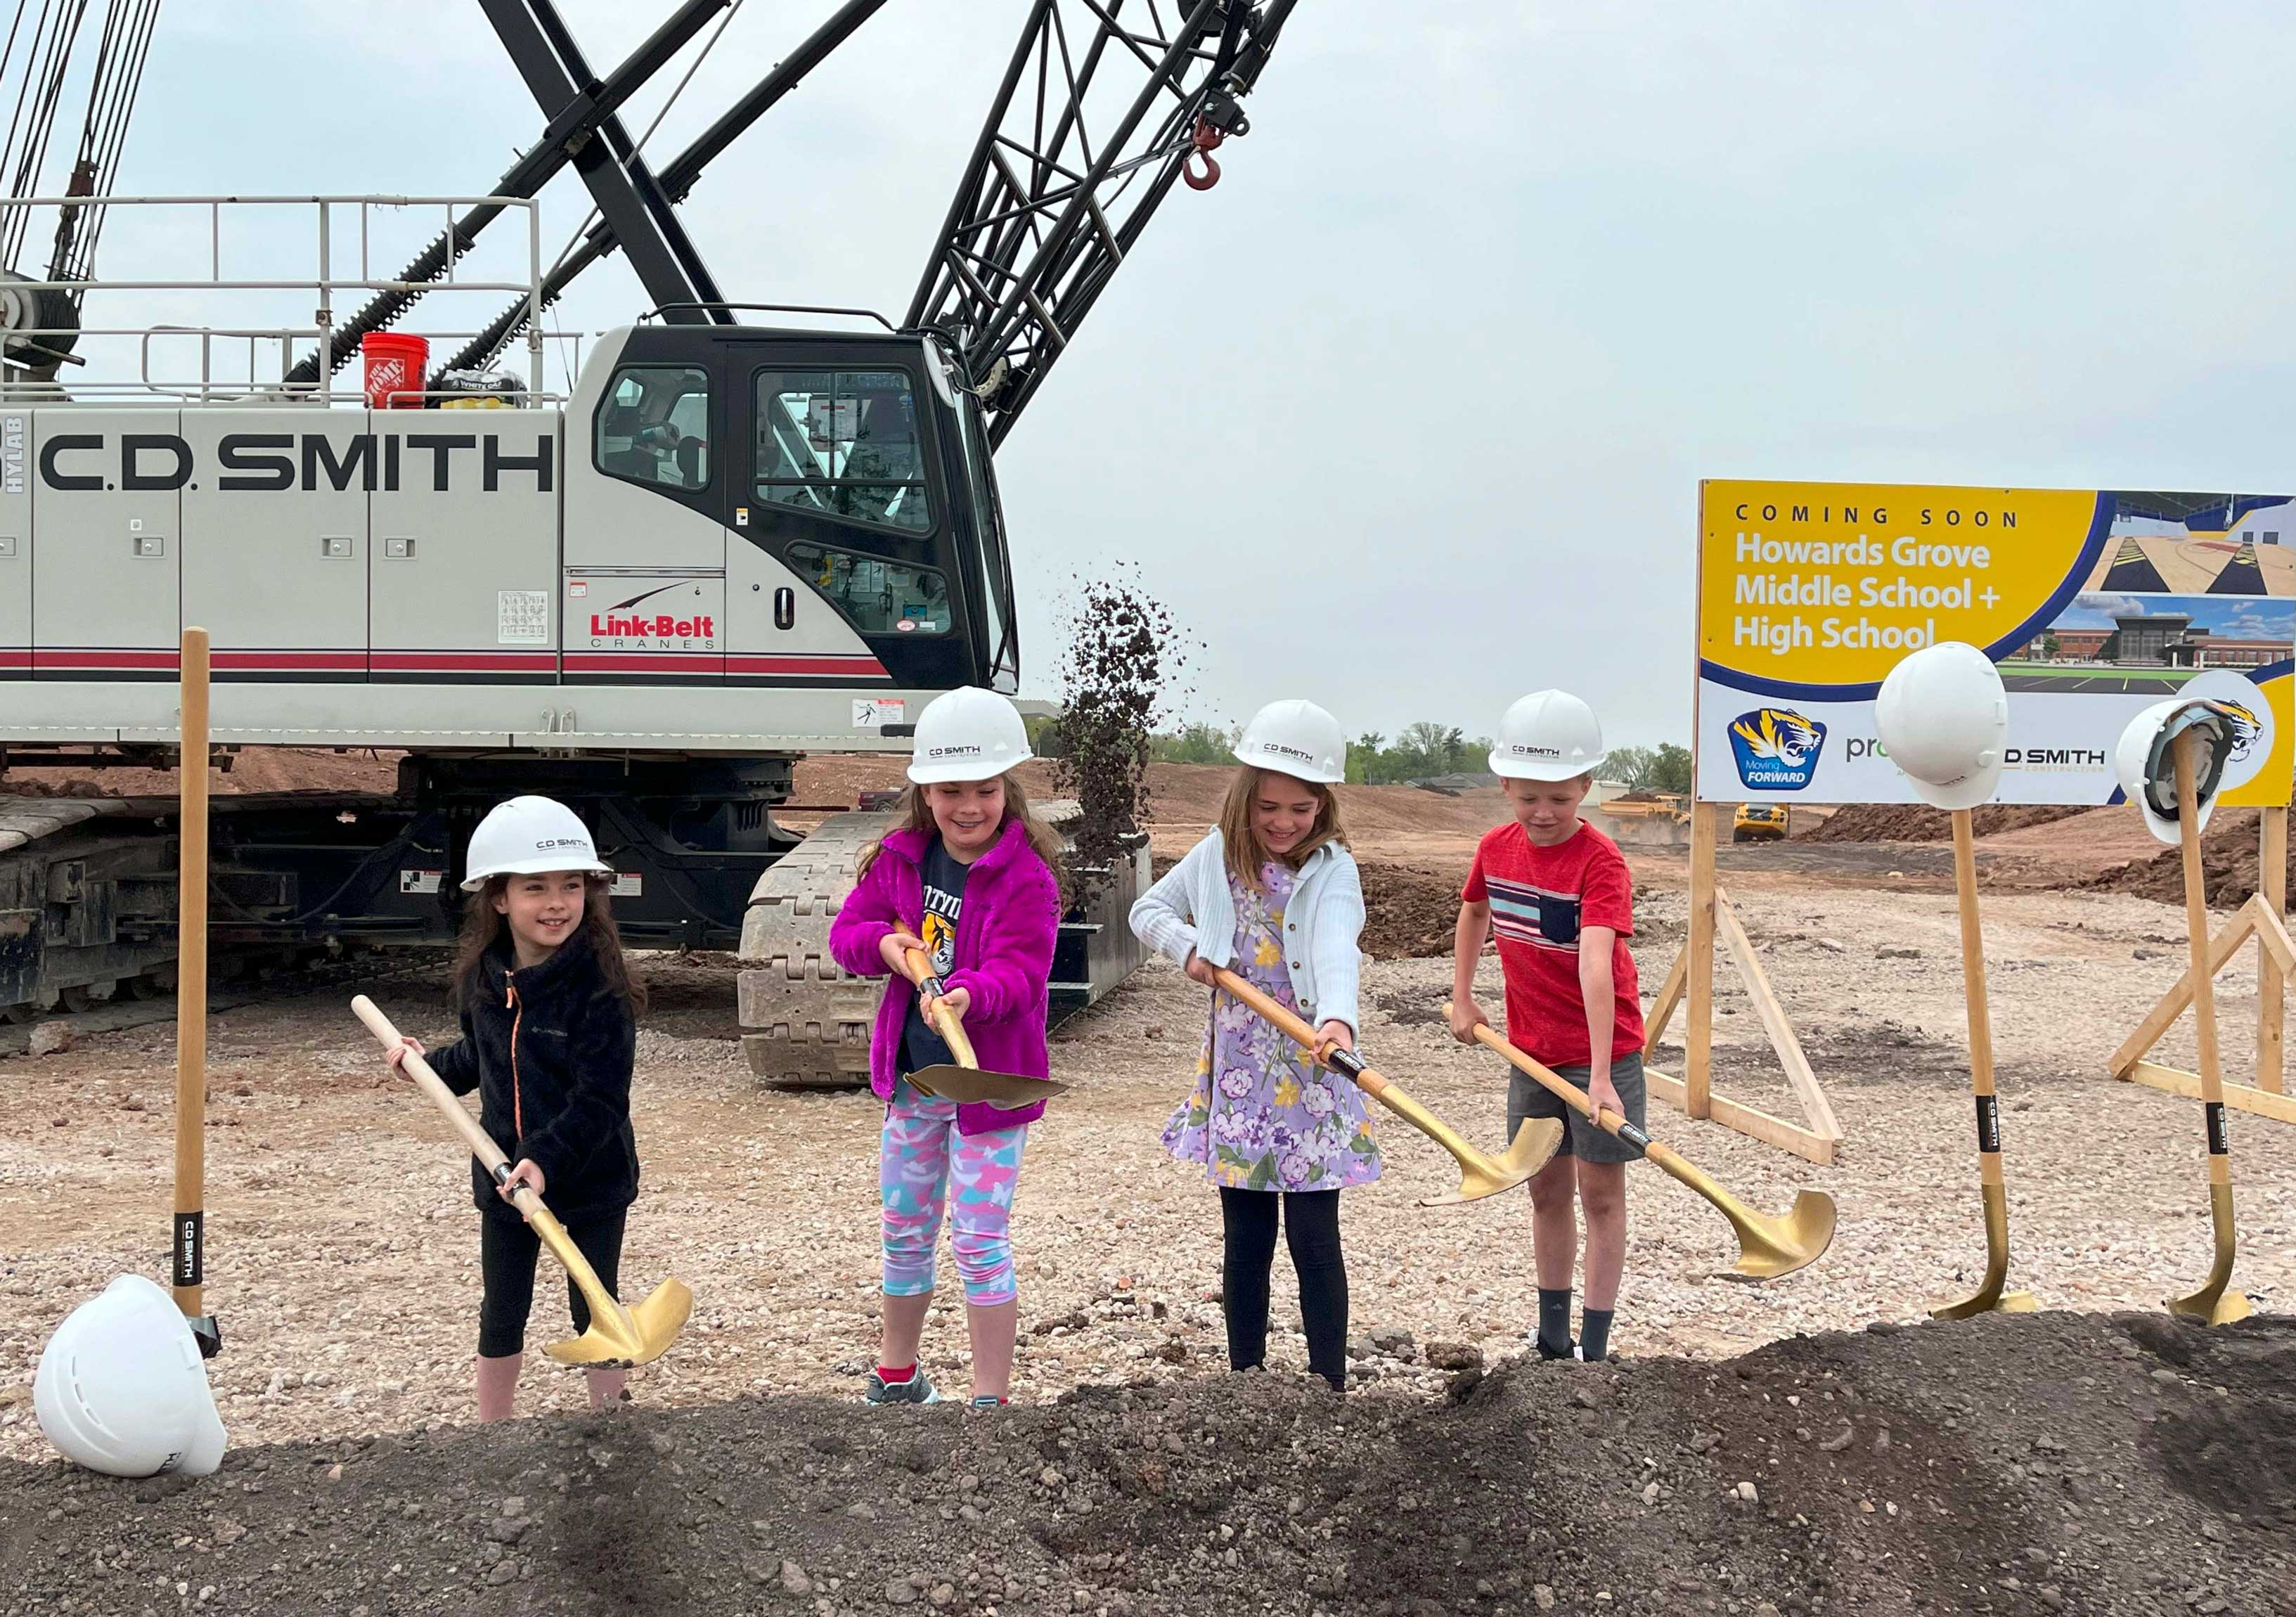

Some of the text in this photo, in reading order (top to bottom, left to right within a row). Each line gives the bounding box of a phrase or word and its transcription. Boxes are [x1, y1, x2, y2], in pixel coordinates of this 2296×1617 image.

[369, 363, 383, 380] THE
[6, 417, 23, 494] HYLAB
[39, 434, 553, 491] C.D. SMITH
[1736, 504, 2017, 528] COMING SOON
[1736, 532, 1991, 568] Howards Grove
[1734, 574, 2001, 609] Middle School +
[591, 614, 714, 638] Link-Belt
[591, 638, 714, 649] CRANES
[1734, 616, 1935, 655] High School
[944, 746, 980, 754] SMITH
[1280, 747, 1313, 761] SMITH
[1526, 747, 1559, 756] SMITH
[2027, 749, 2105, 764] SMITH
[1746, 760, 1780, 771] Moving
[1748, 772, 1805, 782] FORWARD
[536, 840, 555, 849] CD
[557, 839, 588, 847] SMITH
[184, 1241, 194, 1278] SMITH
